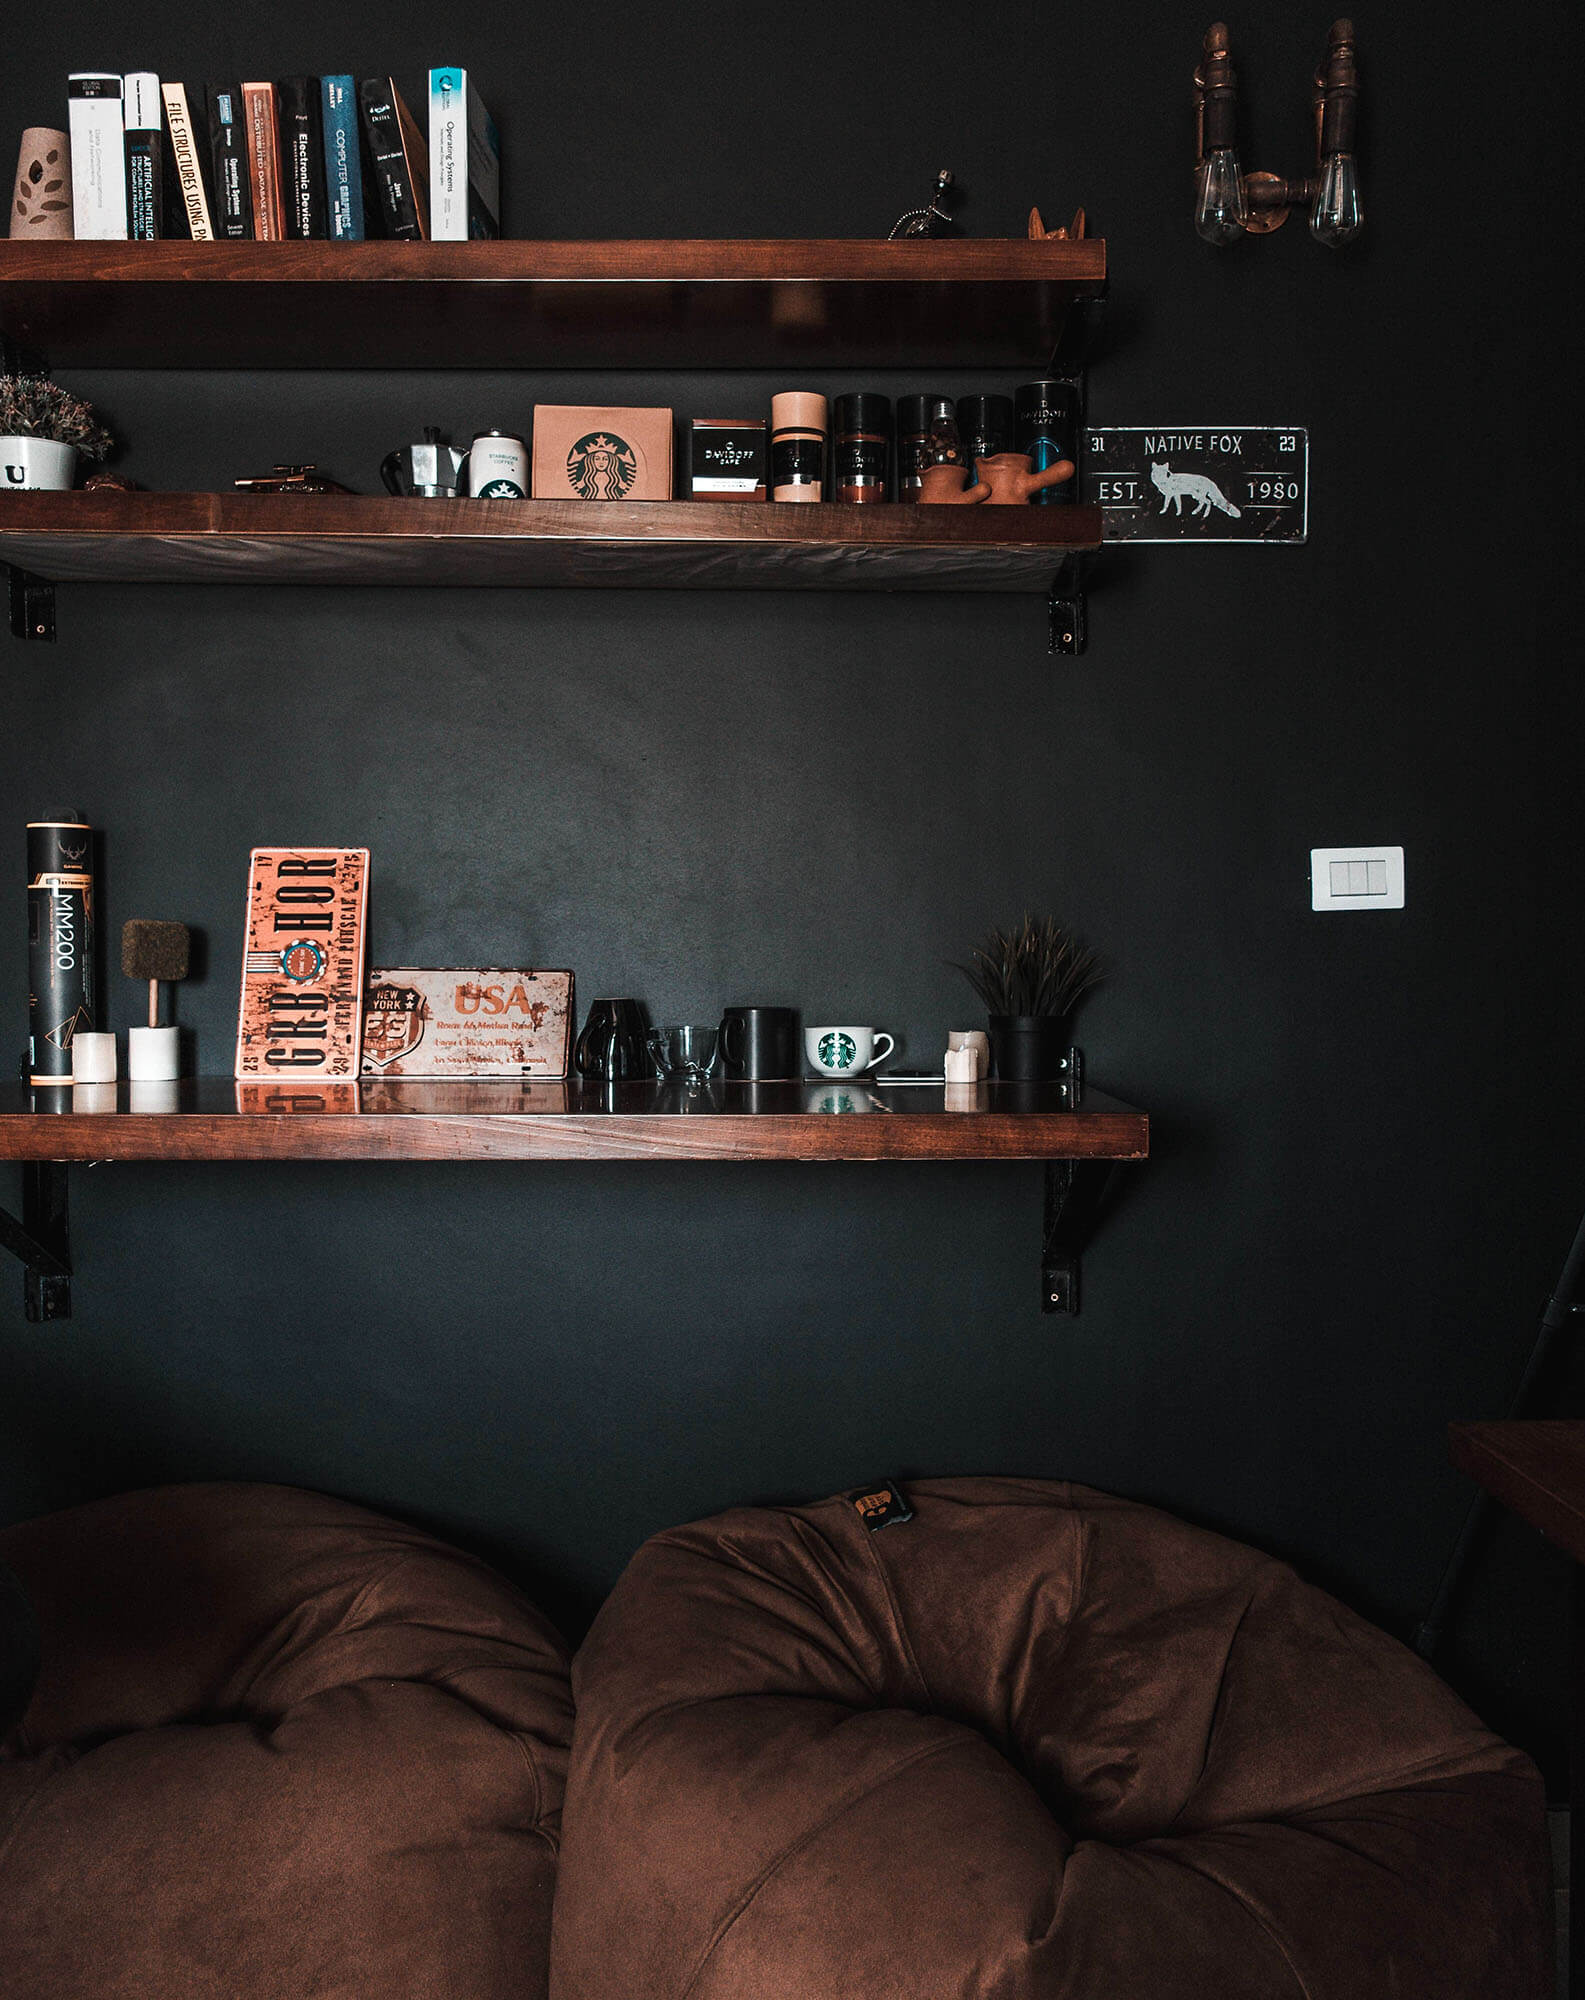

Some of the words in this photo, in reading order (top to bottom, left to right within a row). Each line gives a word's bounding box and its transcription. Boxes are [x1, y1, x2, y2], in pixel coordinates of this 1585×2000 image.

[167, 102, 184, 125] FILE
[254, 118, 264, 169] DISTRIBUTED
[446, 121, 455, 161] Operating
[136, 155, 144, 189] STRUCTURES
[173, 128, 199, 191] STRUCTURES
[299, 133, 310, 190] Electronic
[336, 129, 348, 185] COMPUTER
[143, 155, 153, 200] ARTIFICIAL
[229, 158, 239, 189] Operating
[445, 161, 455, 192] Systems
[231, 189, 241, 216] Systems
[258, 170, 267, 209] DATABASE
[393, 182, 402, 198] Java
[138, 202, 146, 232] STRATEGIES
[144, 201, 155, 241] INTELLIG
[185, 194, 206, 226] USING
[301, 192, 312, 237] Devices
[340, 185, 352, 229] GRAPHICS
[705, 450, 755, 460] DAVIDOFF
[1091, 437, 1105, 452] 31
[1144, 435, 1204, 456] NATIVE
[1209, 435, 1243, 455] FOX
[1279, 436, 1296, 452] 23
[5, 465, 25, 484] U
[1098, 481, 1145, 501] EST.
[1247, 482, 1299, 500] 1980
[256, 855, 273, 867] 17
[273, 858, 338, 933] HOR
[55, 893, 75, 970] MM200
[335, 957, 355, 1026] FERINAND
[372, 1000, 401, 1010] YORK
[376, 990, 399, 1000] NEW
[454, 984, 532, 1015] USA
[264, 991, 330, 1067] GRB
[243, 1056, 259, 1072] 25
[333, 1056, 349, 1074] 29
